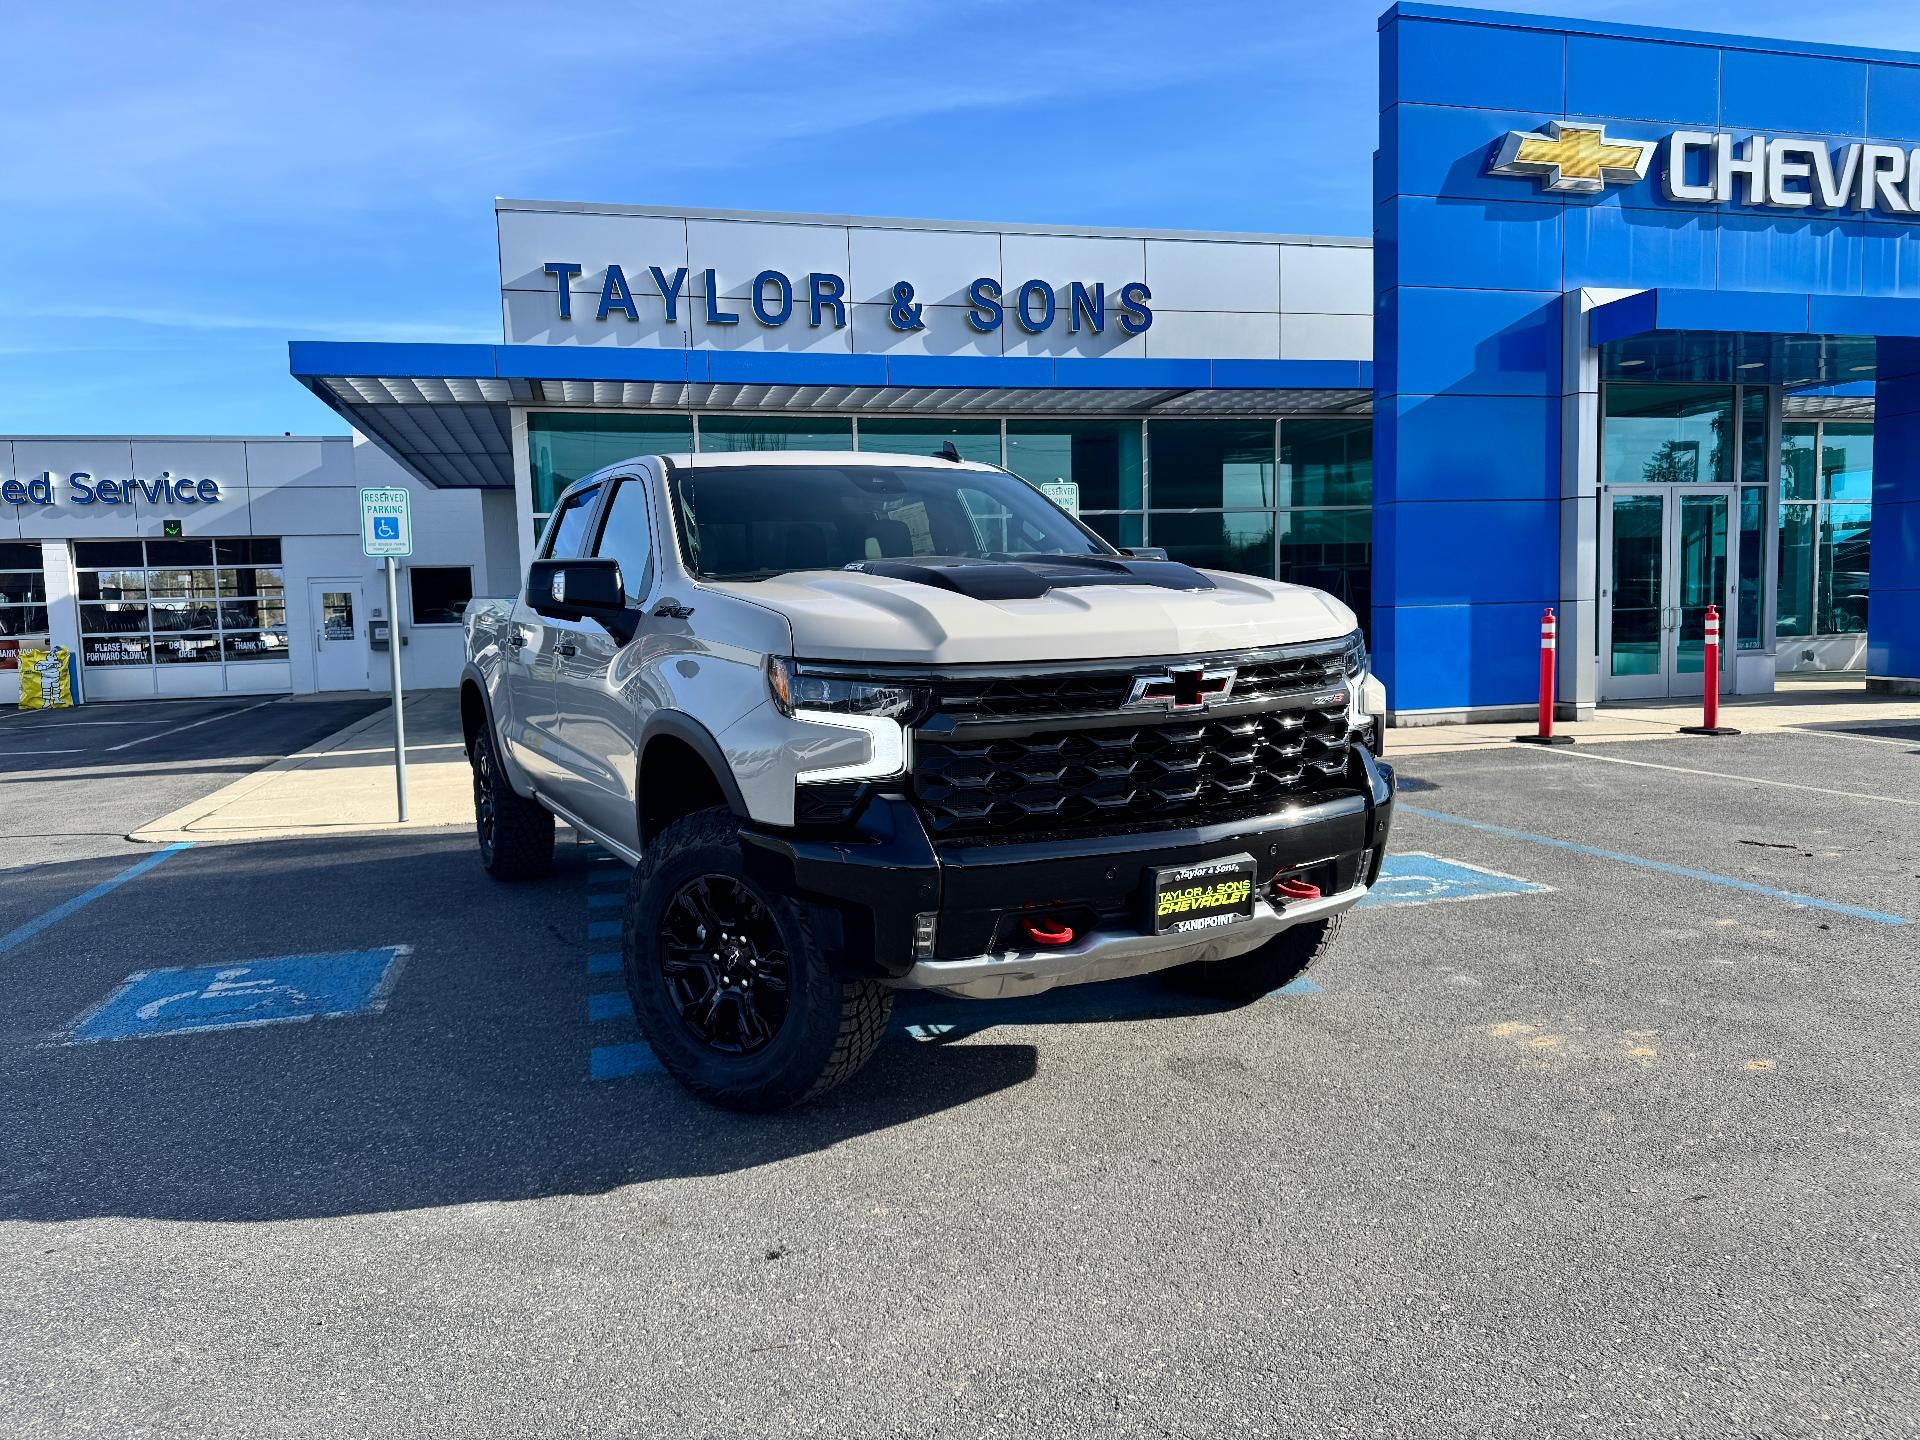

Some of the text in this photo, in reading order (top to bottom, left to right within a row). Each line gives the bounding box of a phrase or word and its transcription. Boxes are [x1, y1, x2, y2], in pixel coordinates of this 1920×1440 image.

[1668, 130, 1920, 212] CHEVR
[543, 262, 1153, 334] TAYLOR & SONS
[69, 471, 220, 505] Service
[364, 493, 404, 503] RESERVED
[367, 505, 403, 514] PARKING
[95, 643, 120, 652] PLEASE
[234, 641, 256, 650] THANK
[87, 651, 148, 661] FORWARD SLOWLY
[179, 649, 197, 658] OPEN
[1180, 868, 1208, 879] Taylor
[1215, 864, 1236, 874] Sons
[1159, 880, 1251, 903] TAYLOR & SONS
[1158, 891, 1250, 916] CHEVROLET
[1178, 914, 1234, 932] SANDPOINT
